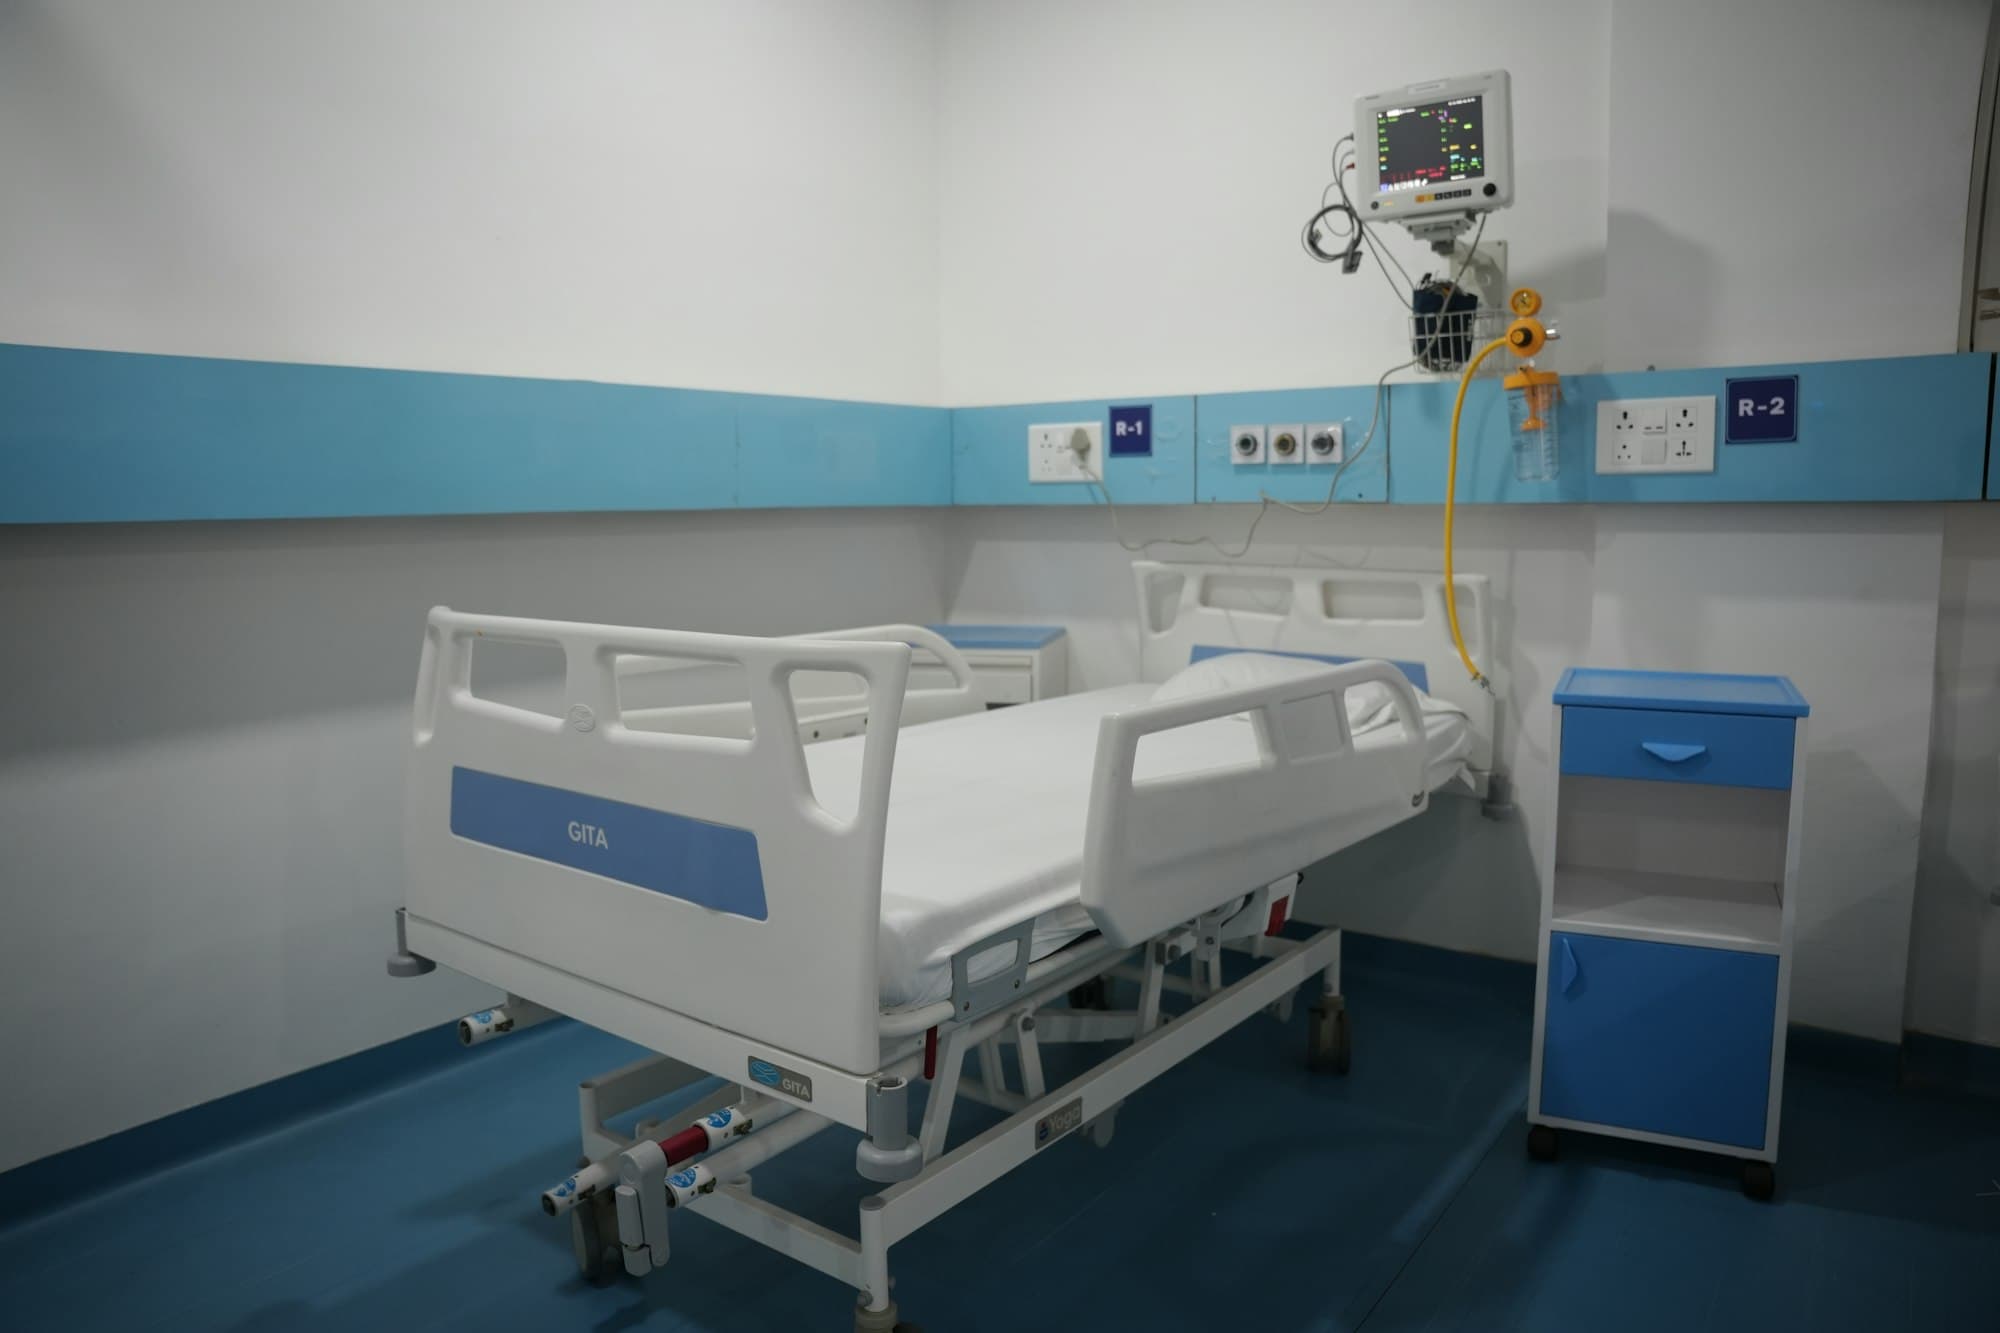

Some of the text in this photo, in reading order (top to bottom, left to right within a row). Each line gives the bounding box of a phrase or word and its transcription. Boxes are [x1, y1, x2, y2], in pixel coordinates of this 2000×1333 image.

[1738, 396, 1785, 416] R-2
[1115, 420, 1143, 436] R-1
[568, 821, 608, 850] GITA
[782, 1078, 810, 1099] GITA
[1049, 1104, 1081, 1132] Yoga
